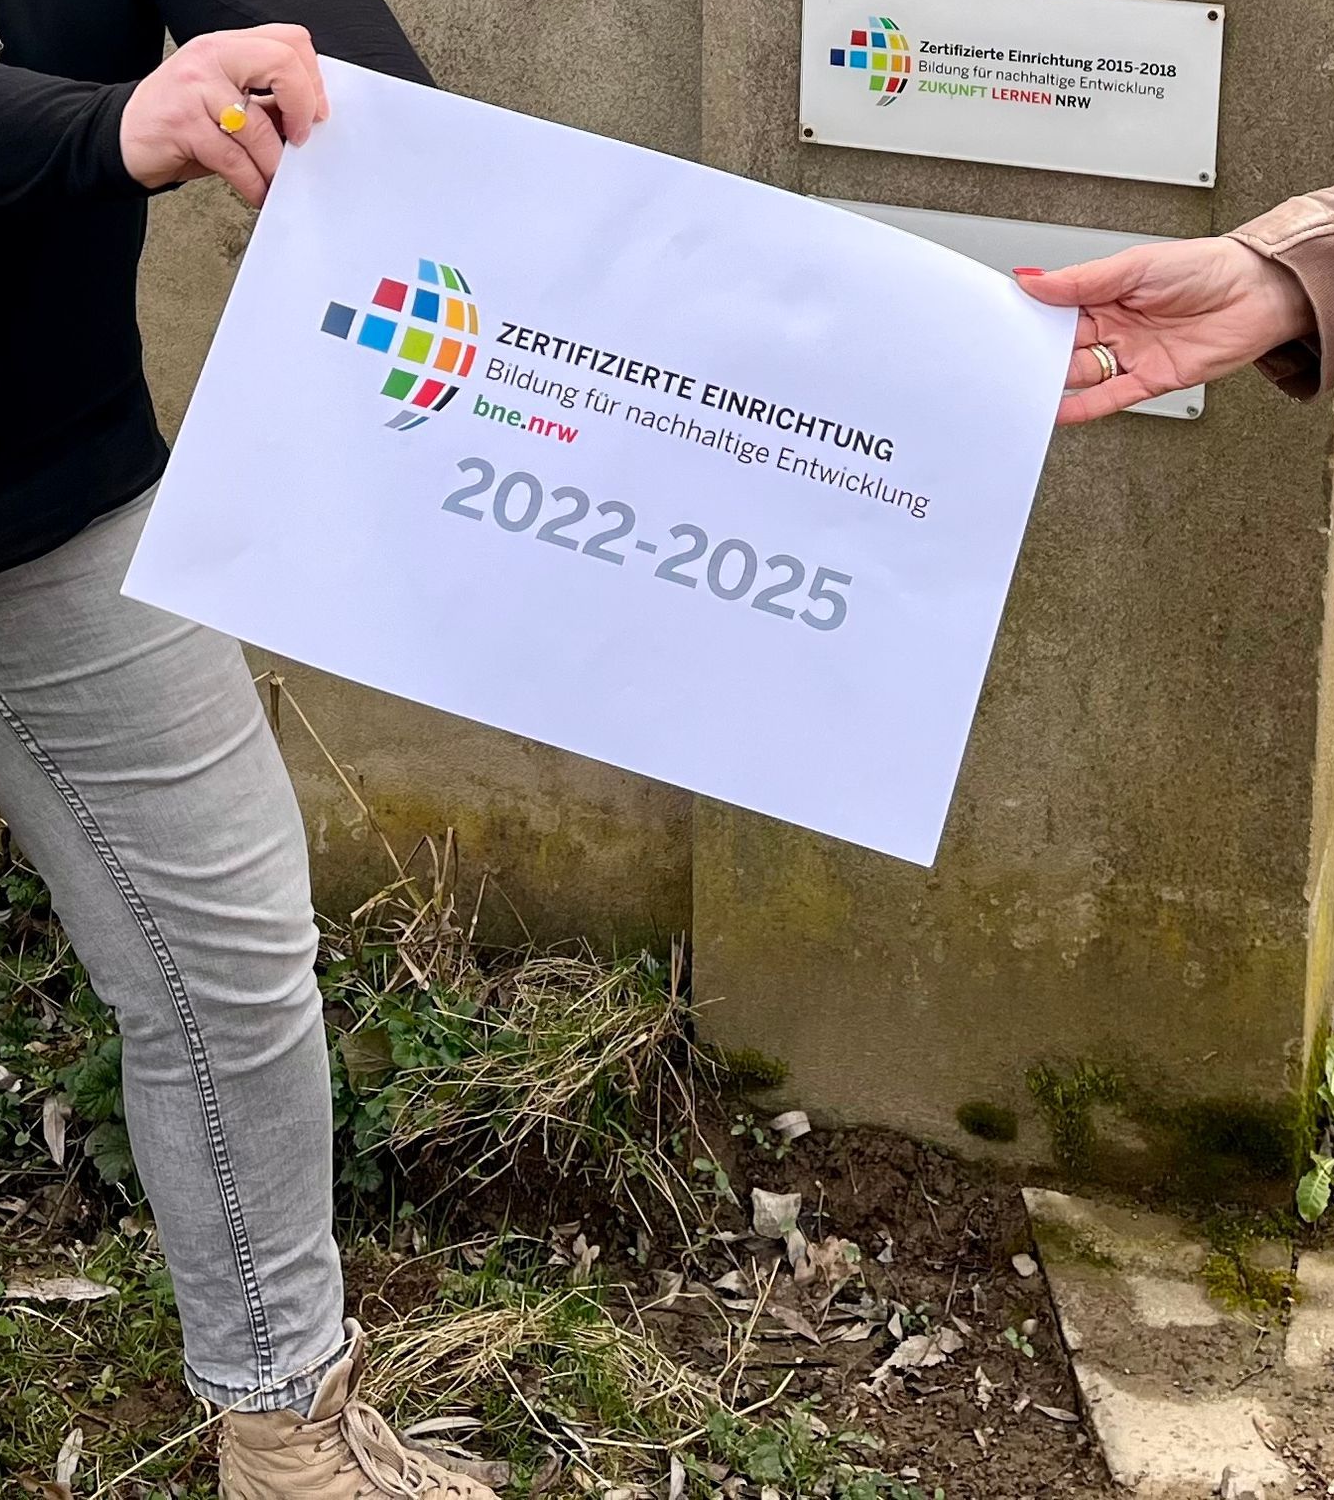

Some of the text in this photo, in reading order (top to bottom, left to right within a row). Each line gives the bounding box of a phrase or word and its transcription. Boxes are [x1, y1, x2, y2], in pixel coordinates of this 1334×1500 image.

[918, 59, 1165, 98] Bildung für nachhaltige Entwicklung
[920, 40, 1177, 77] Zertifizierte Einrichtung 2015-2018
[918, 80, 1091, 109] ZUKUNFT LERNEN NRW
[496, 321, 895, 463] ZERTIFIZIERTE EINRICHTUNG
[473, 394, 579, 445] bne.nrw
[486, 358, 930, 520] Bildung für nachhaltige Entwicklung
[441, 455, 854, 633] 2022-2025
